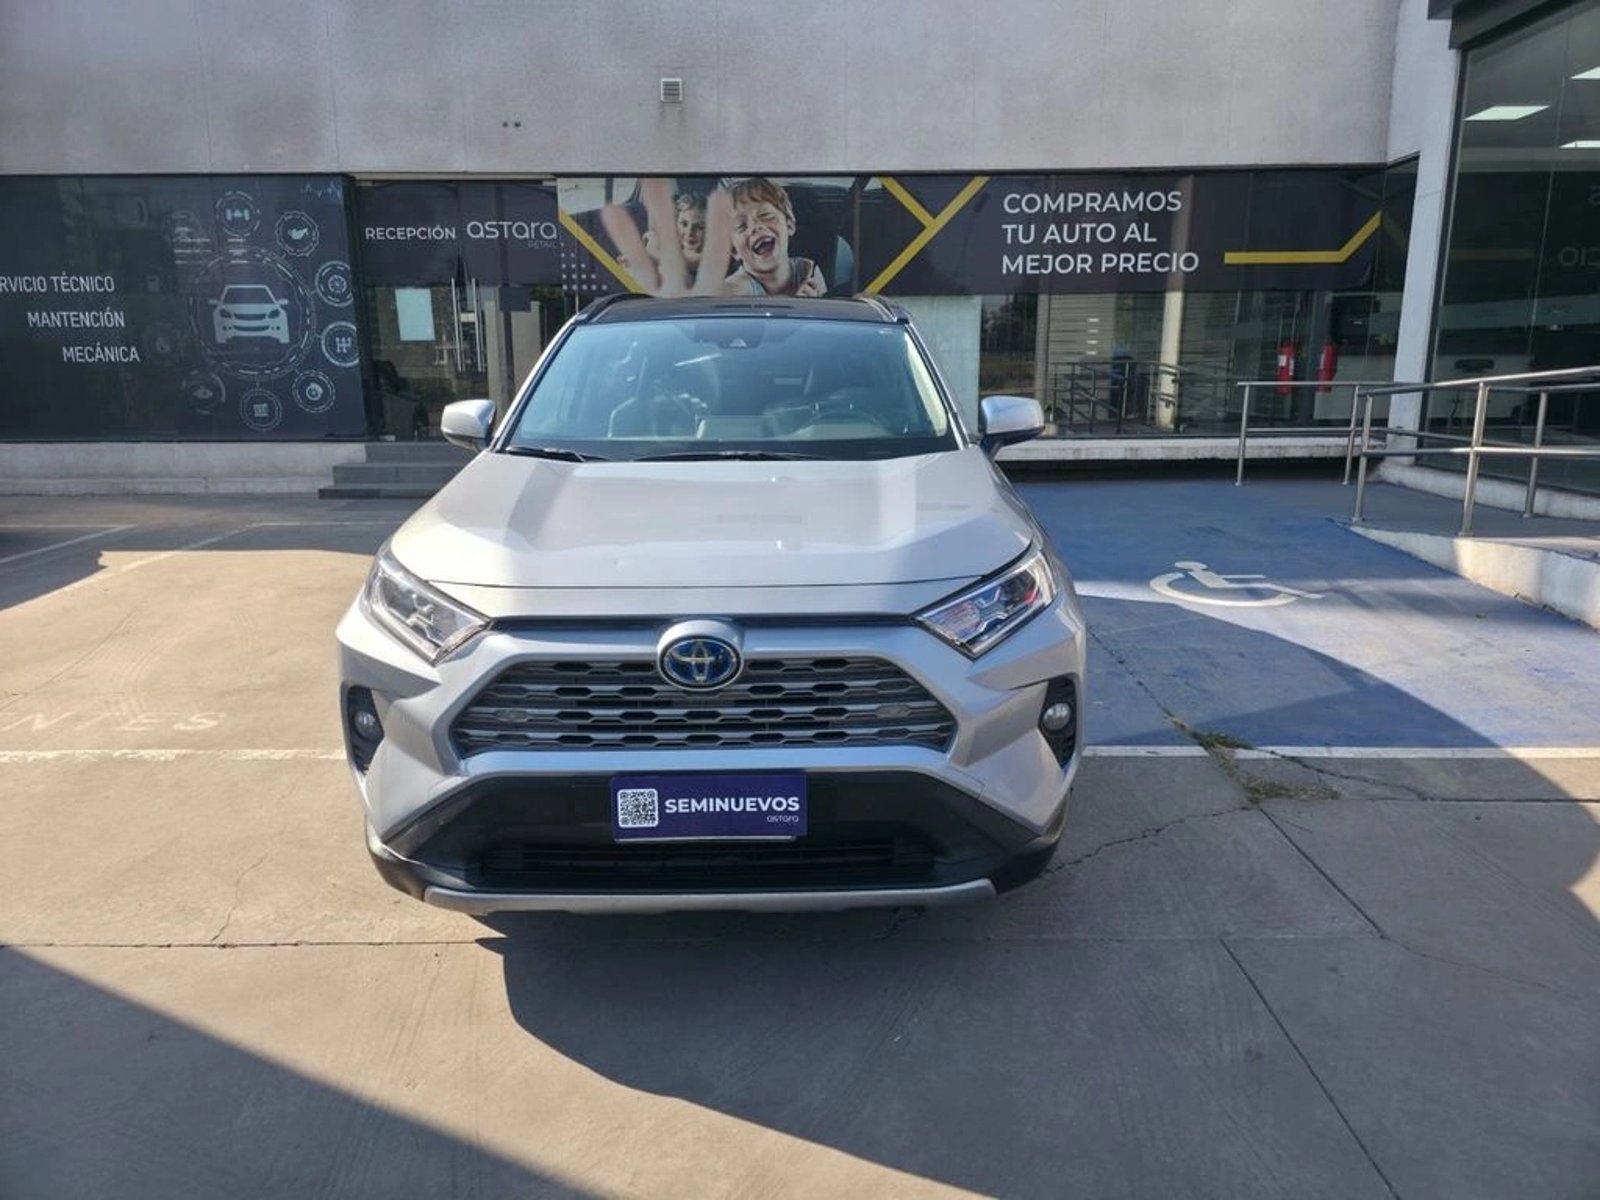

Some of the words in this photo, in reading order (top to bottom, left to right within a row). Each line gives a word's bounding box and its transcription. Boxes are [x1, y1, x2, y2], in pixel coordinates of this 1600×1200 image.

[1003, 191, 1182, 213] COMPRAMOS
[365, 225, 456, 240] RECEPCIÓN
[466, 221, 557, 239] astara
[1002, 223, 1035, 244] TU
[1042, 223, 1116, 243] AUTO
[1122, 222, 1157, 243] AL
[1002, 254, 1093, 274] MEJOR
[1101, 252, 1199, 273] PRECIO
[50, 271, 115, 293] TÉCNICO
[27, 306, 126, 328] MANTENCIÓN
[62, 341, 141, 363] MECÁNICA
[664, 797, 800, 813] SEMINUEVOS
[766, 815, 799, 823] astara
